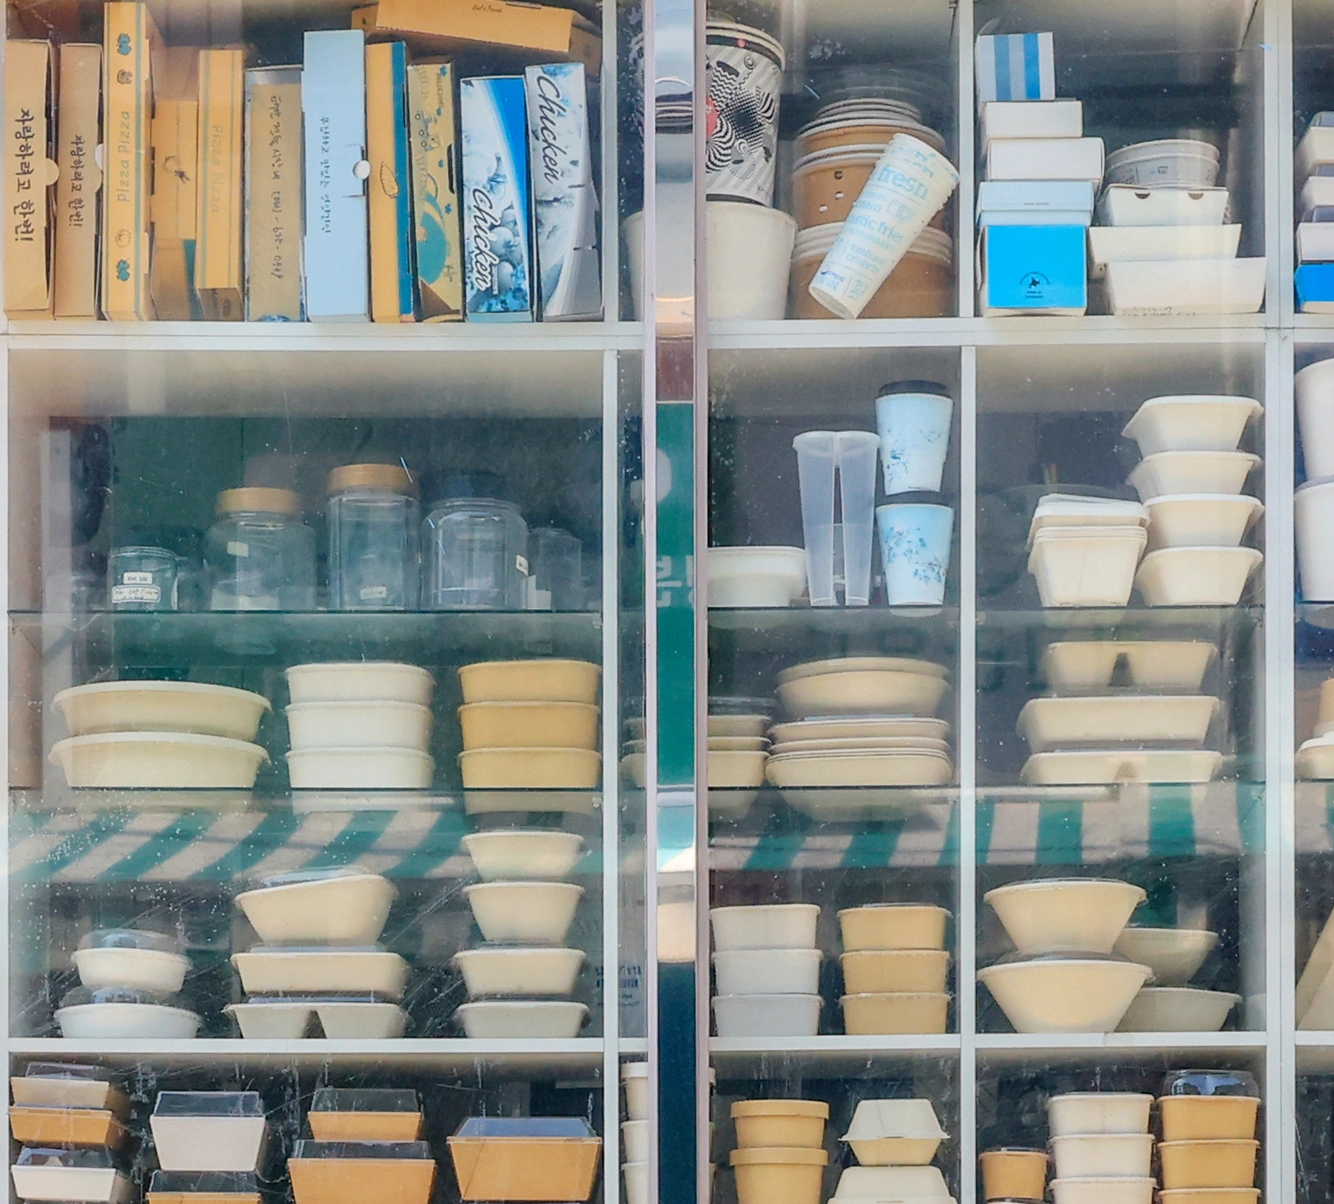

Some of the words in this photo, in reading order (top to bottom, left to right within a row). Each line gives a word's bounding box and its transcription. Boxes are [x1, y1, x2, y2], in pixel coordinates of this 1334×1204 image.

[14, 107, 35, 193] 자랑하려고
[535, 74, 563, 184] Chicken
[13, 198, 35, 242] 한번!
[470, 187, 501, 291] Chicken
